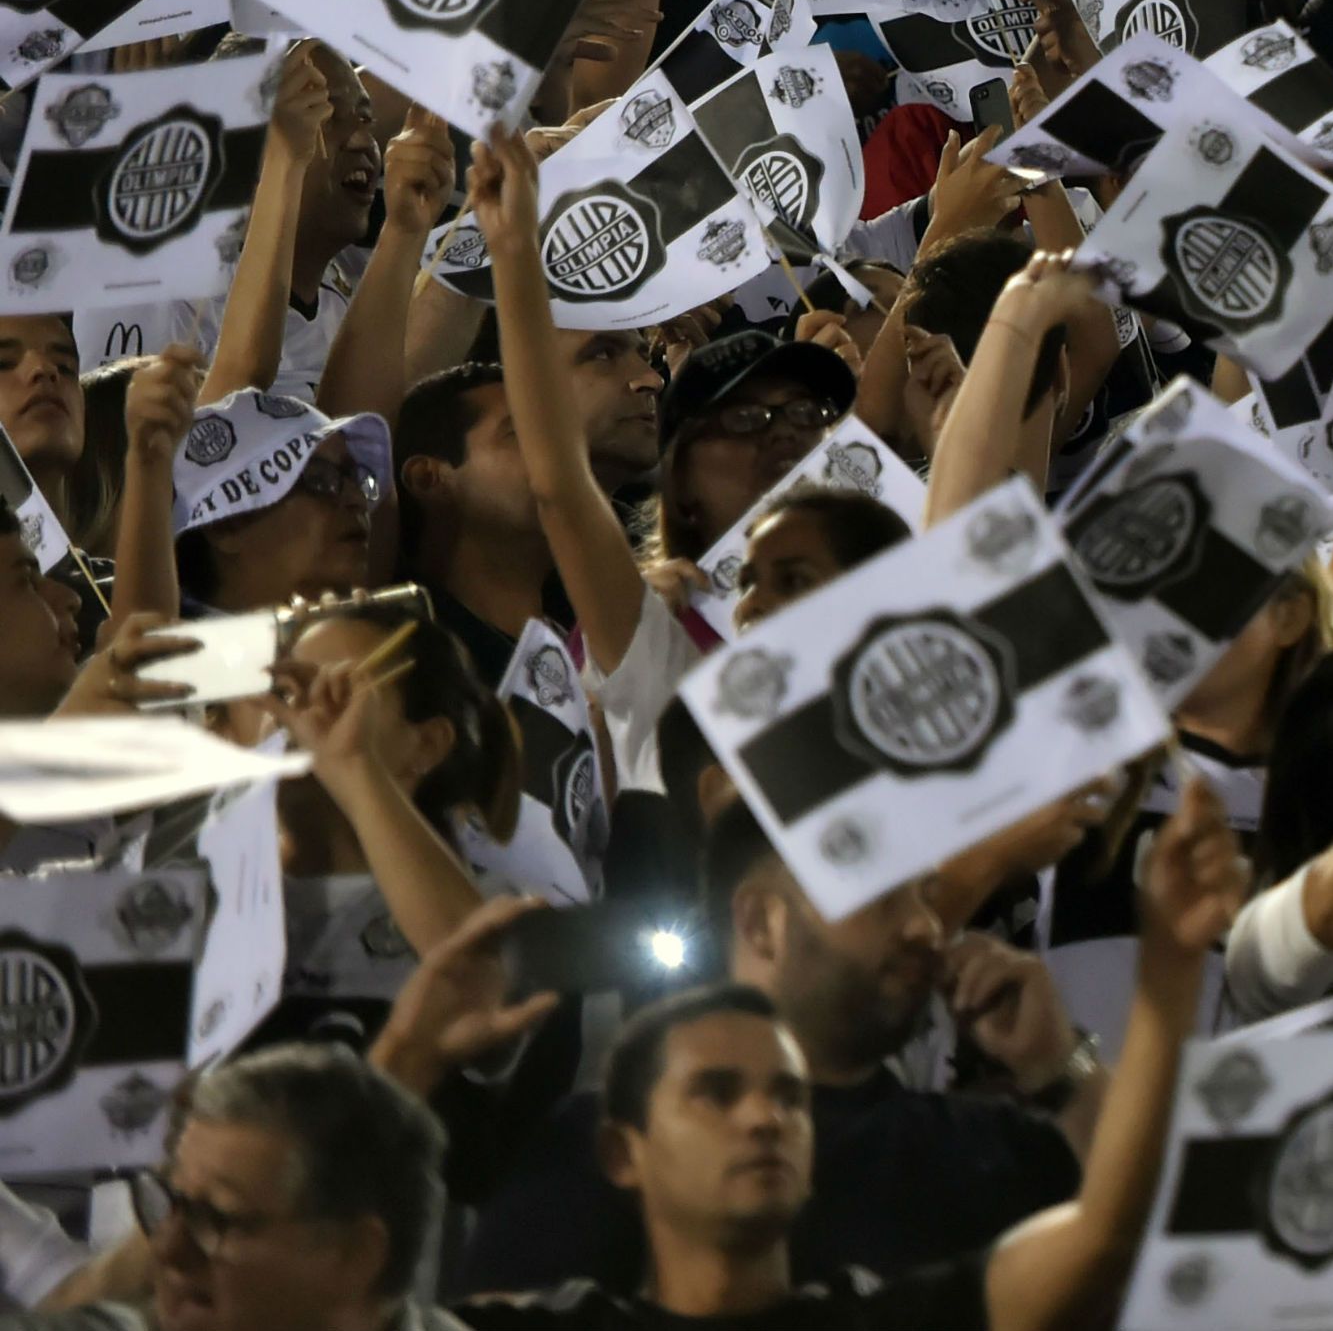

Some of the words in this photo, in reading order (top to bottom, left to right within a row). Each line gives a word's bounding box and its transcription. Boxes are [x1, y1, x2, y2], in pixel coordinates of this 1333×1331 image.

[121, 167, 196, 190] OLIMPIA
[555, 224, 634, 276] OLIMPIA
[220, 467, 260, 503] DE
[259, 432, 320, 484] COPA
